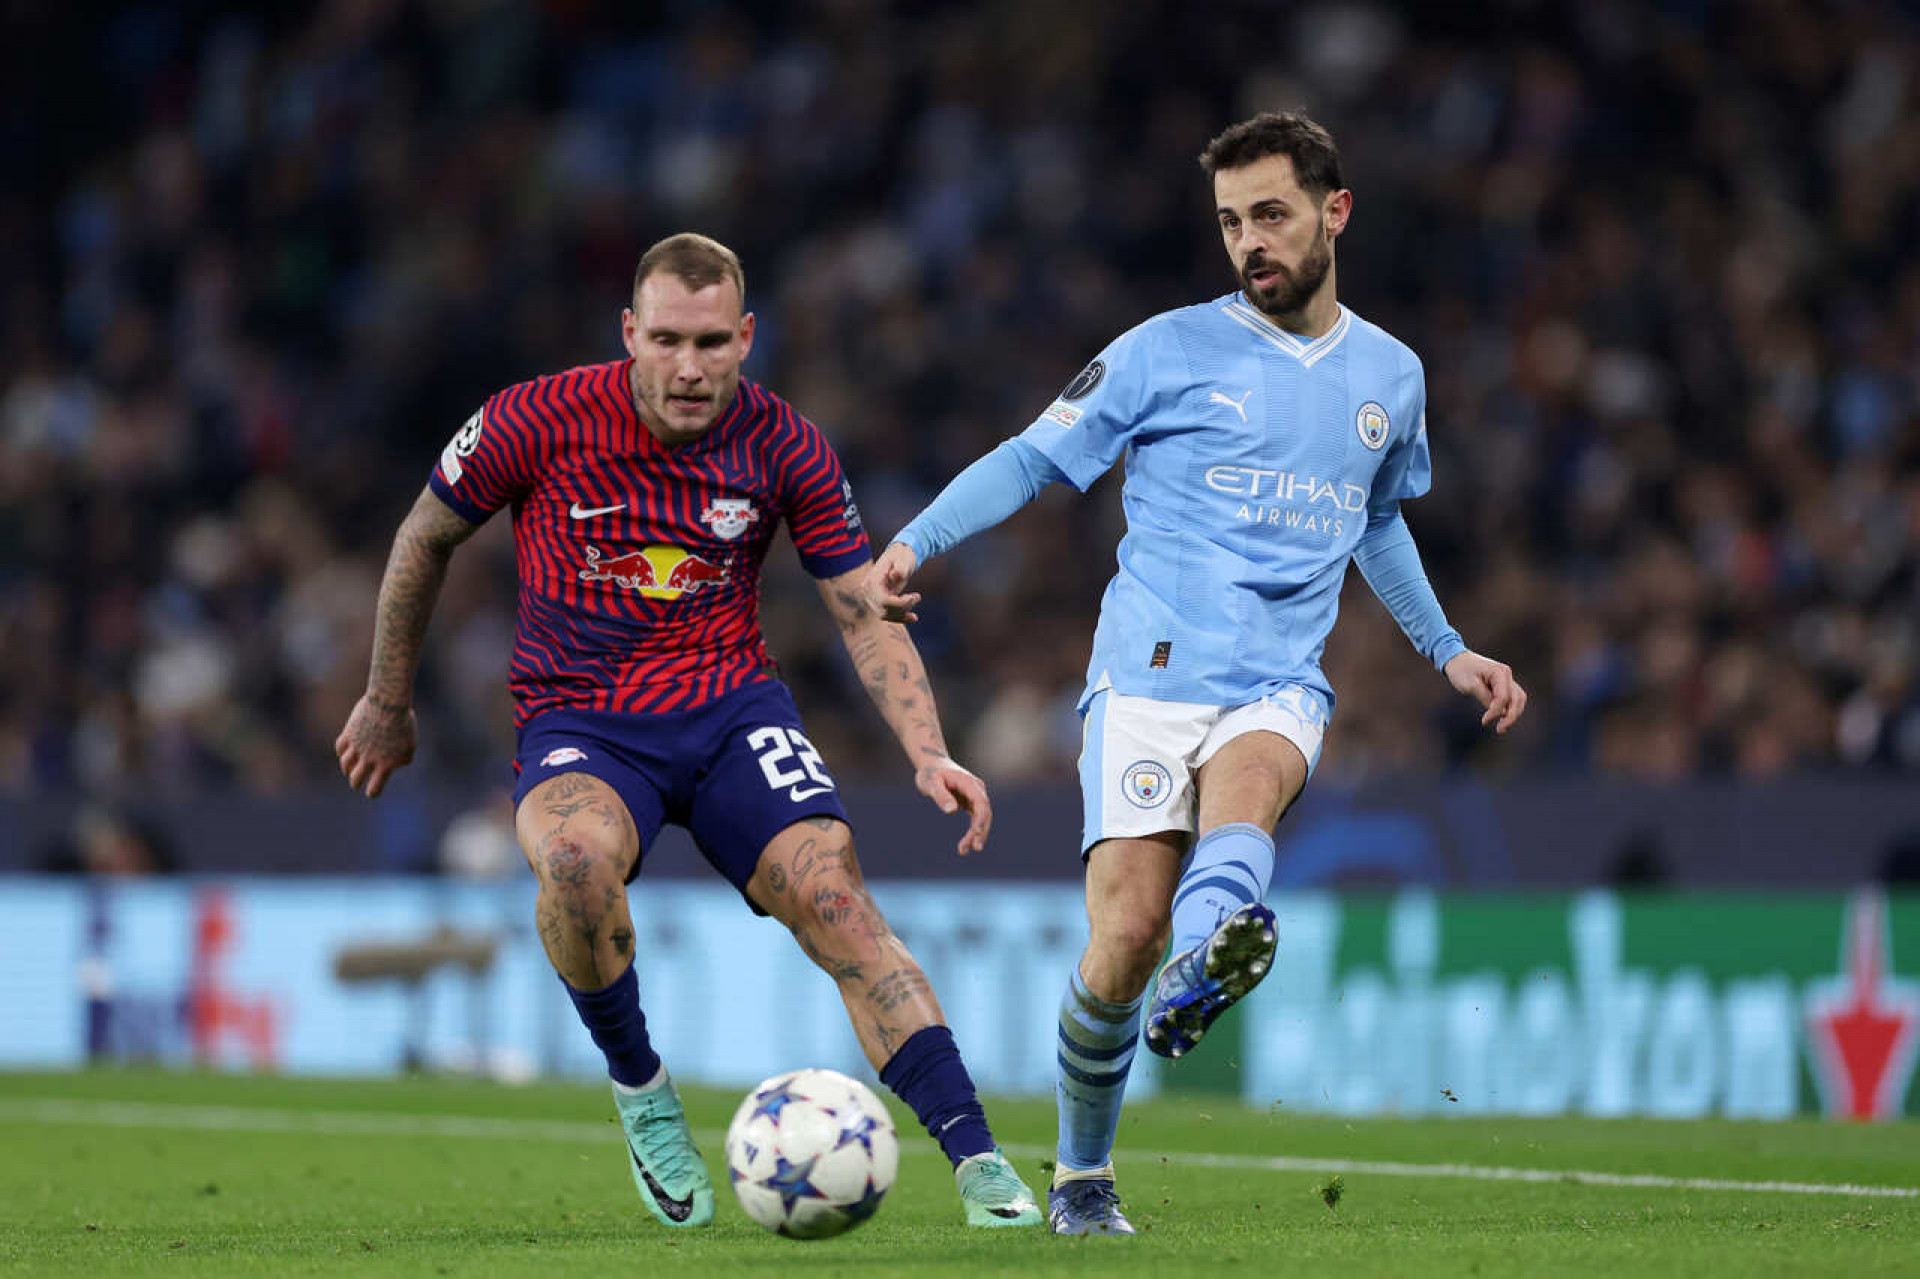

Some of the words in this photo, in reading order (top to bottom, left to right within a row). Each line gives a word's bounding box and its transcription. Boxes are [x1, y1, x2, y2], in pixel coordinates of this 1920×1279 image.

[1205, 465, 1367, 512] ETIHAD
[1235, 503, 1345, 538] AIRWAYS
[746, 726, 835, 790] 22
